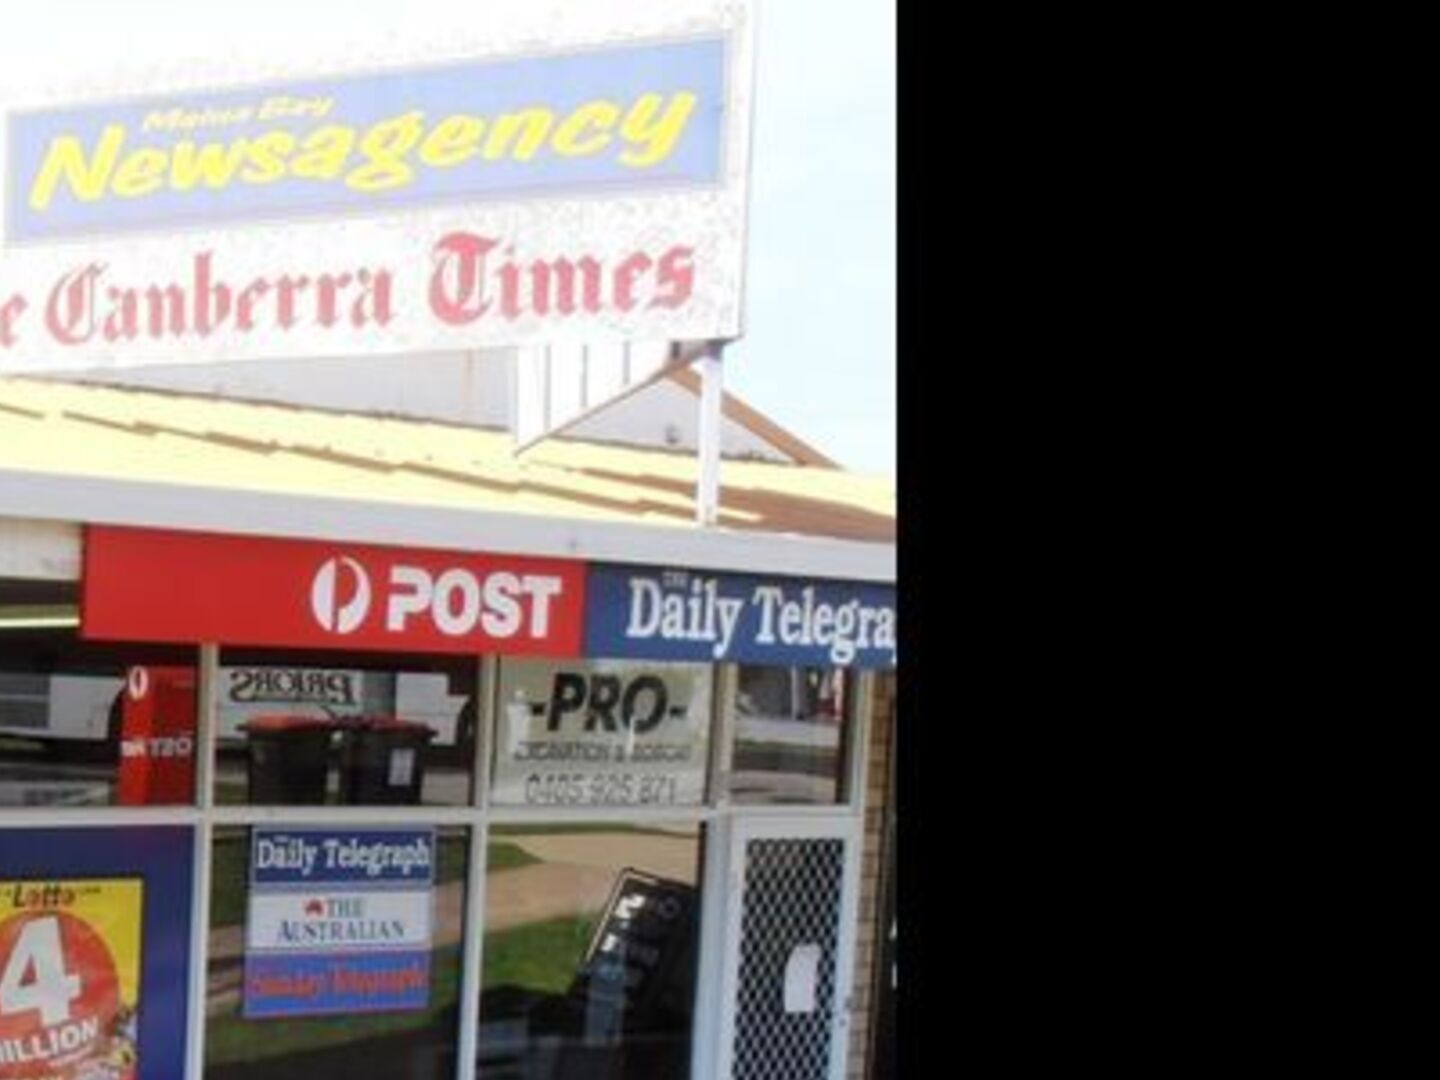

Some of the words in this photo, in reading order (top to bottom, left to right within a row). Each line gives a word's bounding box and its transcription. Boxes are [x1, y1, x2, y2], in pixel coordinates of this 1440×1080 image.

[256, 96, 336, 120] Bay
[27, 90, 696, 213] Newsagency
[45, 251, 393, 348] Canberra
[428, 231, 697, 328] Times
[387, 564, 562, 639] POST
[626, 577, 743, 659] Daily
[752, 586, 897, 665] Telegra
[257, 837, 317, 876] Daily
[323, 837, 430, 876] Telegraph
[278, 919, 406, 941] AUSTRALIAN
[327, 899, 363, 917] THE
